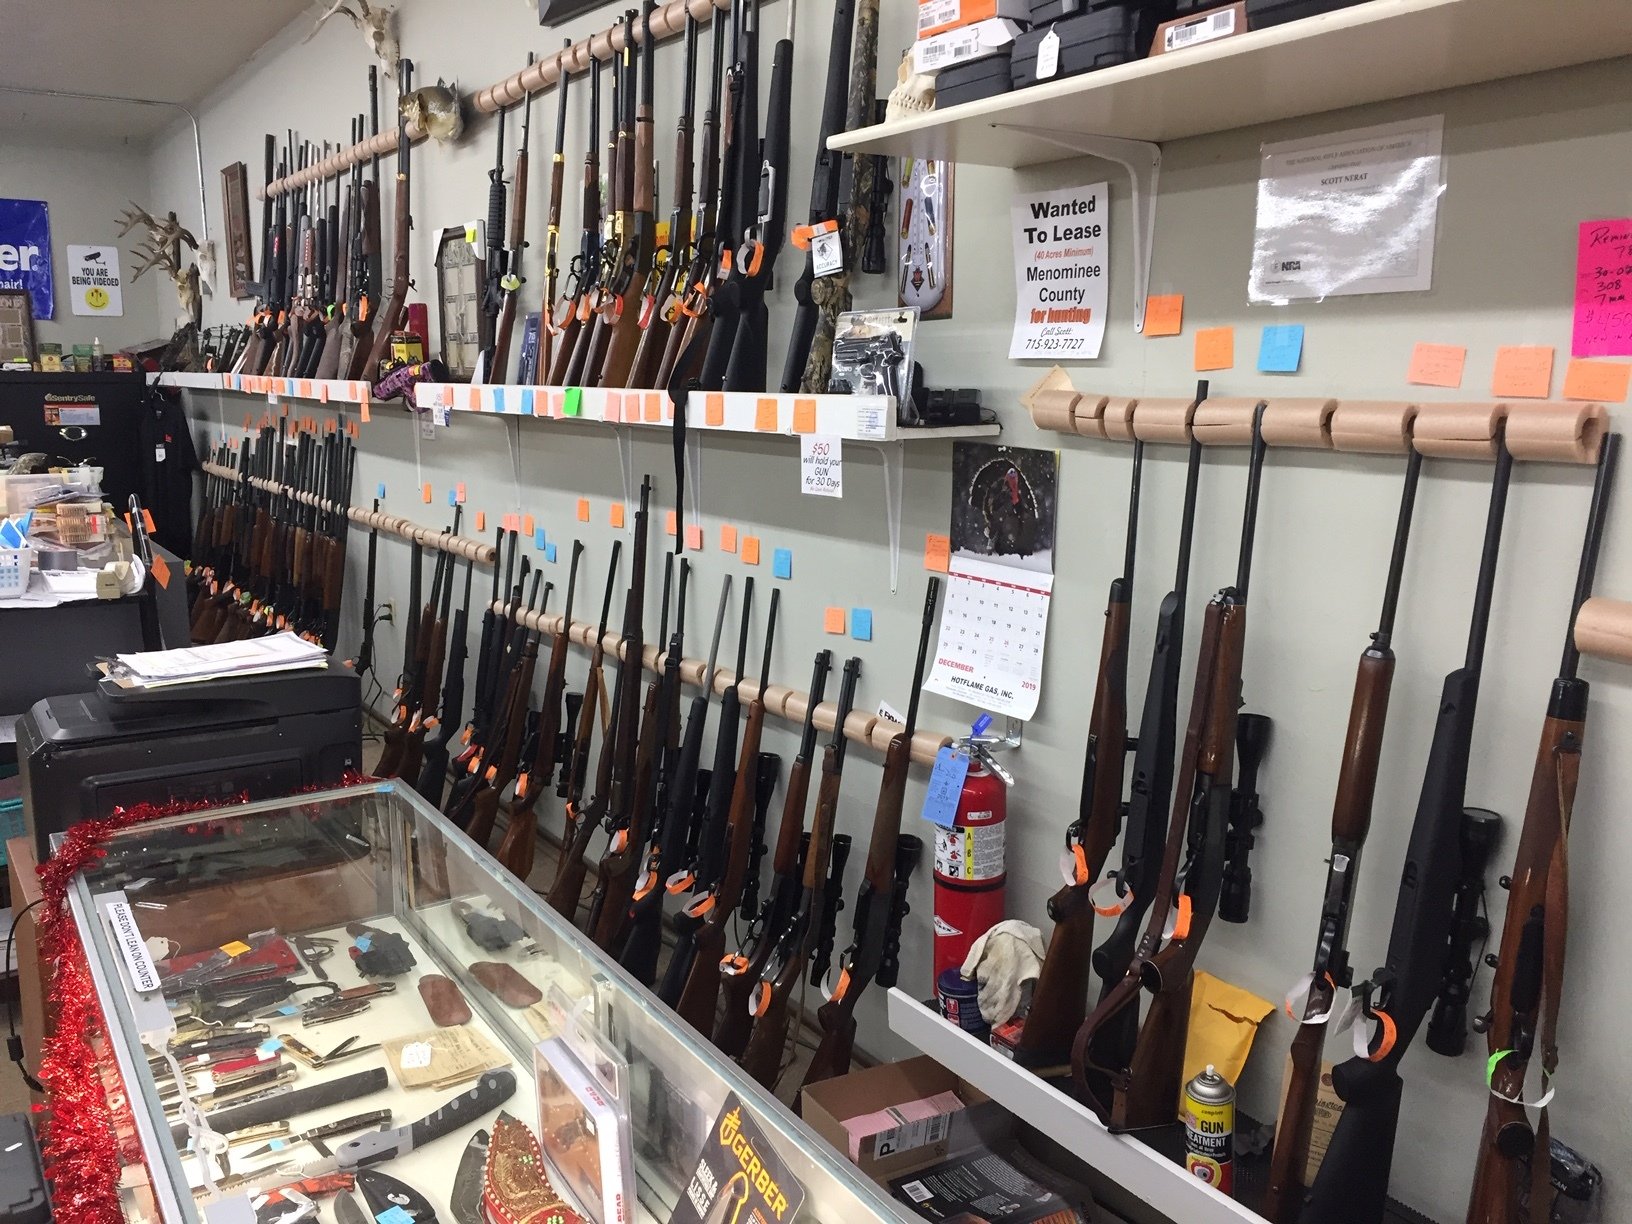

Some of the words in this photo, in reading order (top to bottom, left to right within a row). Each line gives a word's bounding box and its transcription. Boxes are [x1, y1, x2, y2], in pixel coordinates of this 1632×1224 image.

[1321, 176, 1343, 186] SCOTT
[1030, 195, 1096, 219] Wanted
[1024, 227, 1048, 244] To
[1053, 224, 1102, 242] Lease
[1034, 250, 1045, 262] (40
[1045, 249, 1063, 260] Acres
[1063, 245, 1094, 258] Minimum)
[816, 259, 838, 271] ACCURACY
[82, 267, 95, 277] YOU
[96, 268, 109, 277] ARE
[1026, 264, 1101, 282] Menominee
[72, 276, 92, 286] BEING
[92, 277, 119, 287] VIDEOED
[1597, 279, 1621, 292] 308
[1039, 287, 1086, 305] County
[1030, 308, 1047, 324] for
[1047, 306, 1092, 325] hunting
[1040, 327, 1055, 338] Call
[1025, 338, 1085, 350] 715-923-7727
[51, 394, 96, 402] SentrySafe
[812, 443, 830, 456] $50
[803, 456, 815, 464] will
[815, 456, 829, 465] hold
[829, 459, 841, 468] your
[815, 467, 830, 476] GUN
[806, 476, 815, 485] for
[816, 477, 825, 486] 30
[826, 477, 840, 490] Days
[938, 657, 974, 674] DECEMBER
[950, 675, 984, 691] HOTFLAME
[984, 685, 999, 696] GAS,
[1000, 689, 1014, 700] INC.
[1021, 681, 1037, 691] 2019
[966, 832, 972, 841] A
[966, 866, 972, 875] C
[113, 903, 128, 922] PLEASE
[126, 937, 140, 954] LEAN
[134, 960, 154, 989] COUNTER
[1200, 1120, 1224, 1134] GUN
[1186, 1125, 1226, 1148] REATMENT
[732, 1135, 789, 1222] GERBER
